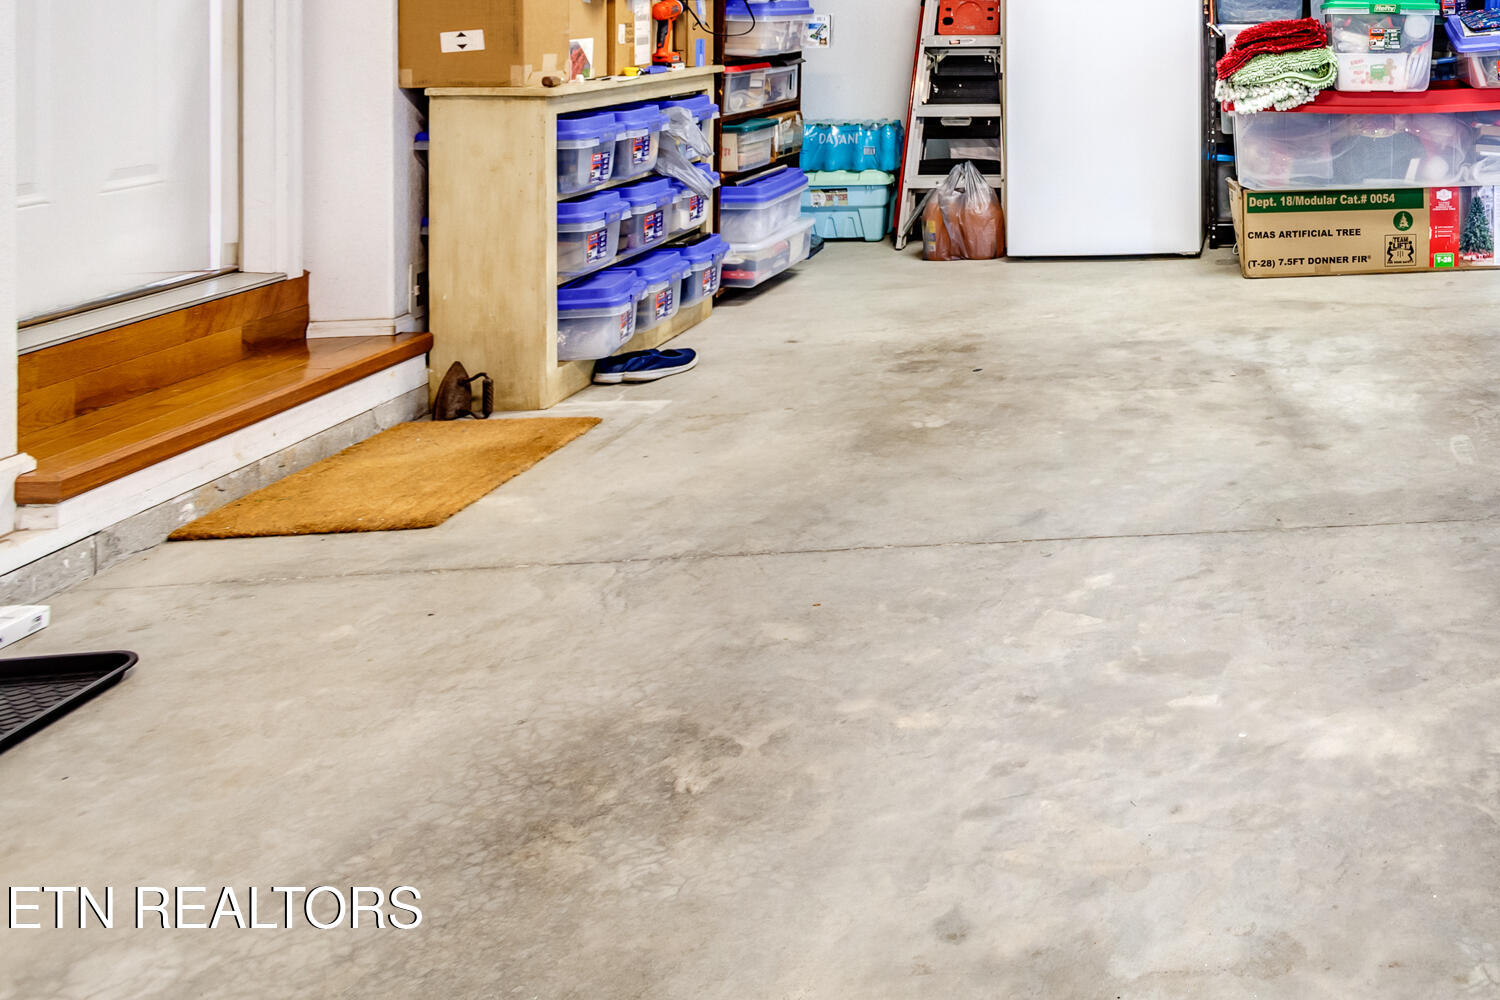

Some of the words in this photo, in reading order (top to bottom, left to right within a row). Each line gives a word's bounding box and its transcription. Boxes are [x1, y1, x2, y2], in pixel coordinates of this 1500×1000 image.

[818, 132, 860, 148] DASANI
[1249, 196, 1277, 209] Dept.
[1280, 194, 1337, 207] 18/Modular
[1339, 193, 1367, 205] Cat.#
[1370, 193, 1396, 204] 0054
[1247, 231, 1276, 240] CMAS
[1278, 229, 1333, 239] ARTIFICIAL
[1336, 228, 1361, 237] TREE
[1247, 259, 1276, 269] (T-28)
[1278, 257, 1305, 267] 7.5FT
[1308, 256, 1349, 266] DONNER
